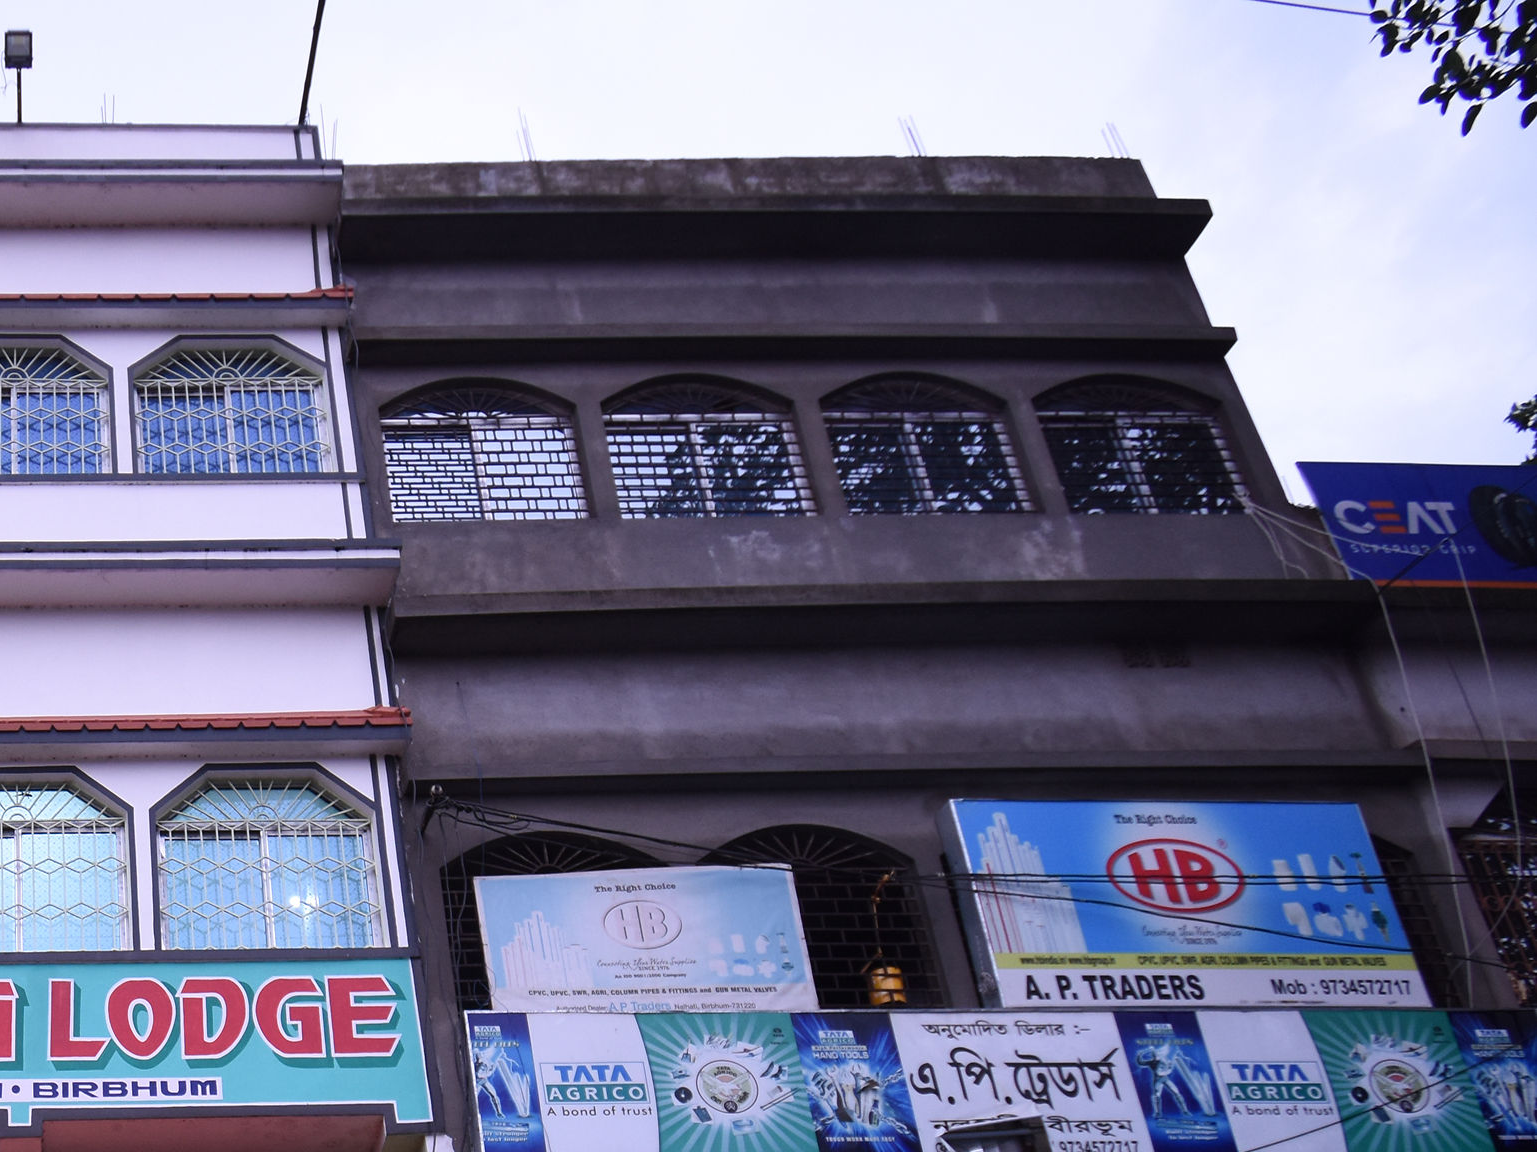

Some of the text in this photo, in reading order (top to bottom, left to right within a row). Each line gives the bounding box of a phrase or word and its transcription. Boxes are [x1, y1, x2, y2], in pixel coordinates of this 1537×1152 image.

[1333, 500, 1458, 534] CEAT
[1114, 814, 1198, 826] The Right Choice
[1128, 848, 1221, 904] HB
[594, 882, 676, 893] The Right Choice
[1026, 975, 1205, 1000] A. P. TRADERS
[1270, 979, 1308, 995] Mob
[1319, 979, 1411, 996] 9734572717
[609, 1001, 617, 1011] A
[620, 1001, 628, 1011] P
[630, 1000, 671, 1011] Traders
[48, 975, 405, 1064] LODGE
[921, 1020, 1008, 1040] অনুমোদিত
[1014, 1020, 1065, 1036] ডিলার
[840, 1051, 869, 1059] TOOLS
[554, 1064, 632, 1083] TATA
[1231, 1064, 1310, 1082] TATA
[33, 1078, 219, 1100] BIRBHUM
[549, 1086, 644, 1101] AGRICO
[1230, 1086, 1323, 1100] AGRICO
[547, 1105, 652, 1117] A bond of trust
[1232, 1105, 1334, 1116] A bond of trust
[1044, 1115, 1134, 1137] বীরভূম
